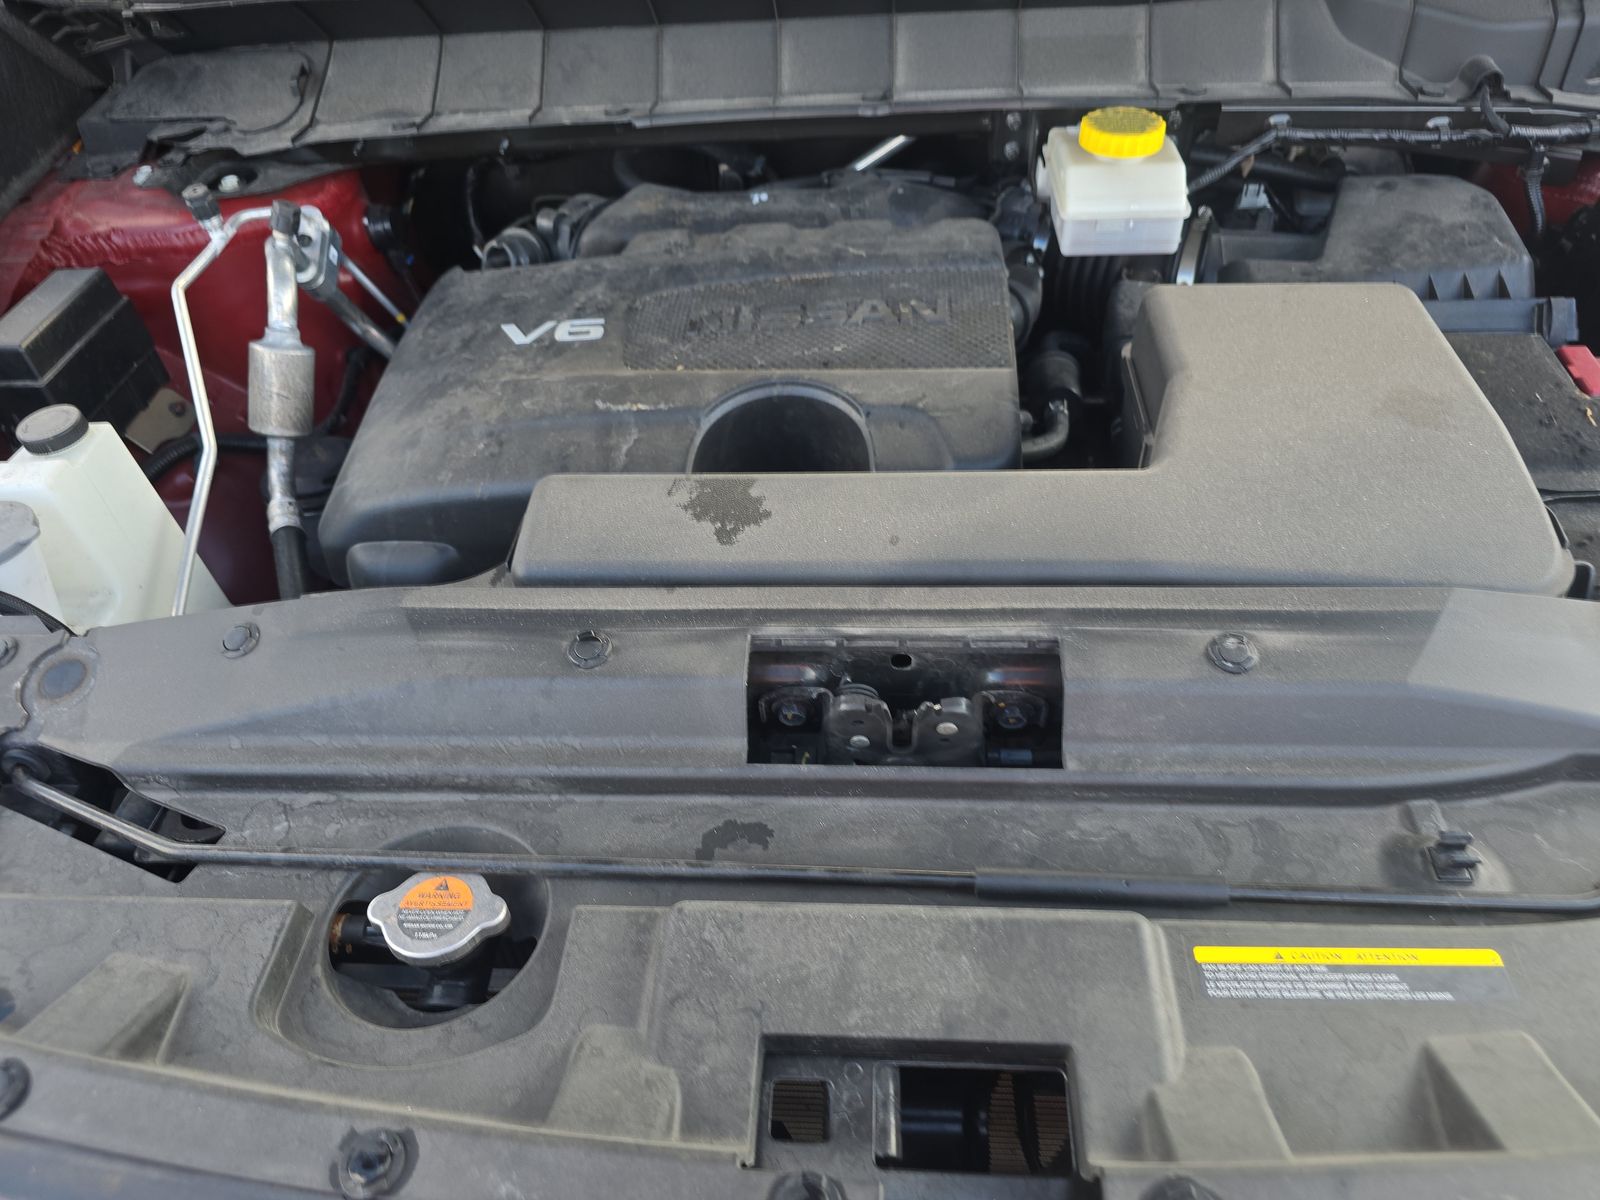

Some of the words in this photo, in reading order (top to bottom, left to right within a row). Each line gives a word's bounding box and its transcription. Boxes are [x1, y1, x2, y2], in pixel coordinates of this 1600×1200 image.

[500, 318, 605, 345] V6
[418, 892, 462, 900] WARNING
[1291, 951, 1343, 961] CAUTION
